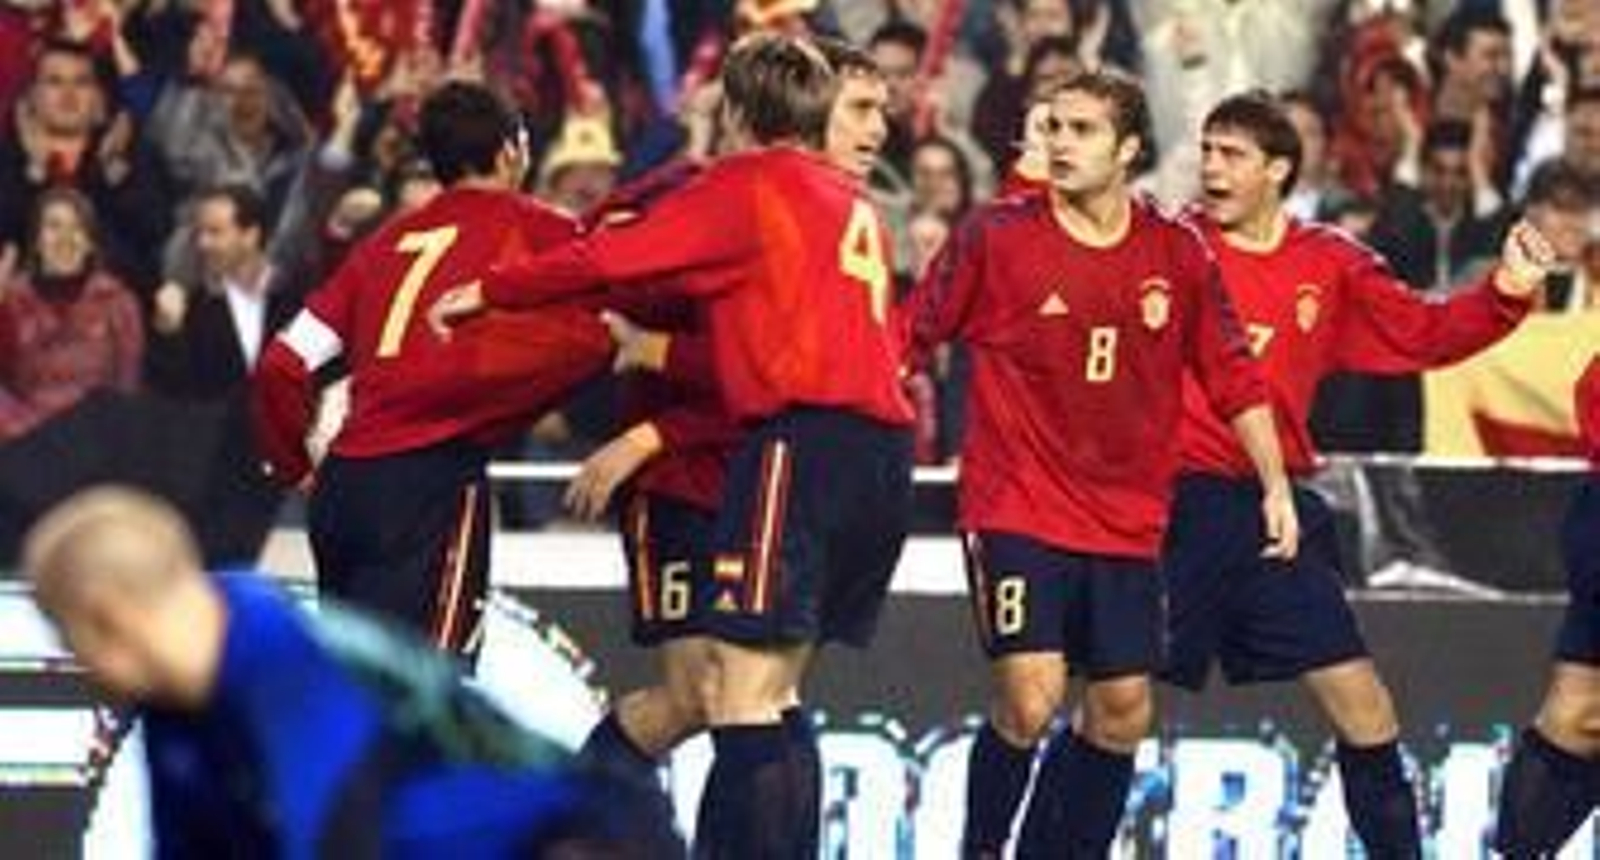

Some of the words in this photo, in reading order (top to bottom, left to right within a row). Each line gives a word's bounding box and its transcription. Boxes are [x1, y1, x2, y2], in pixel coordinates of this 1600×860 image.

[377, 225, 458, 357] 7
[838, 199, 889, 324] 4
[1086, 327, 1117, 382] 8
[661, 561, 690, 620] 6
[996, 576, 1026, 635] 8
